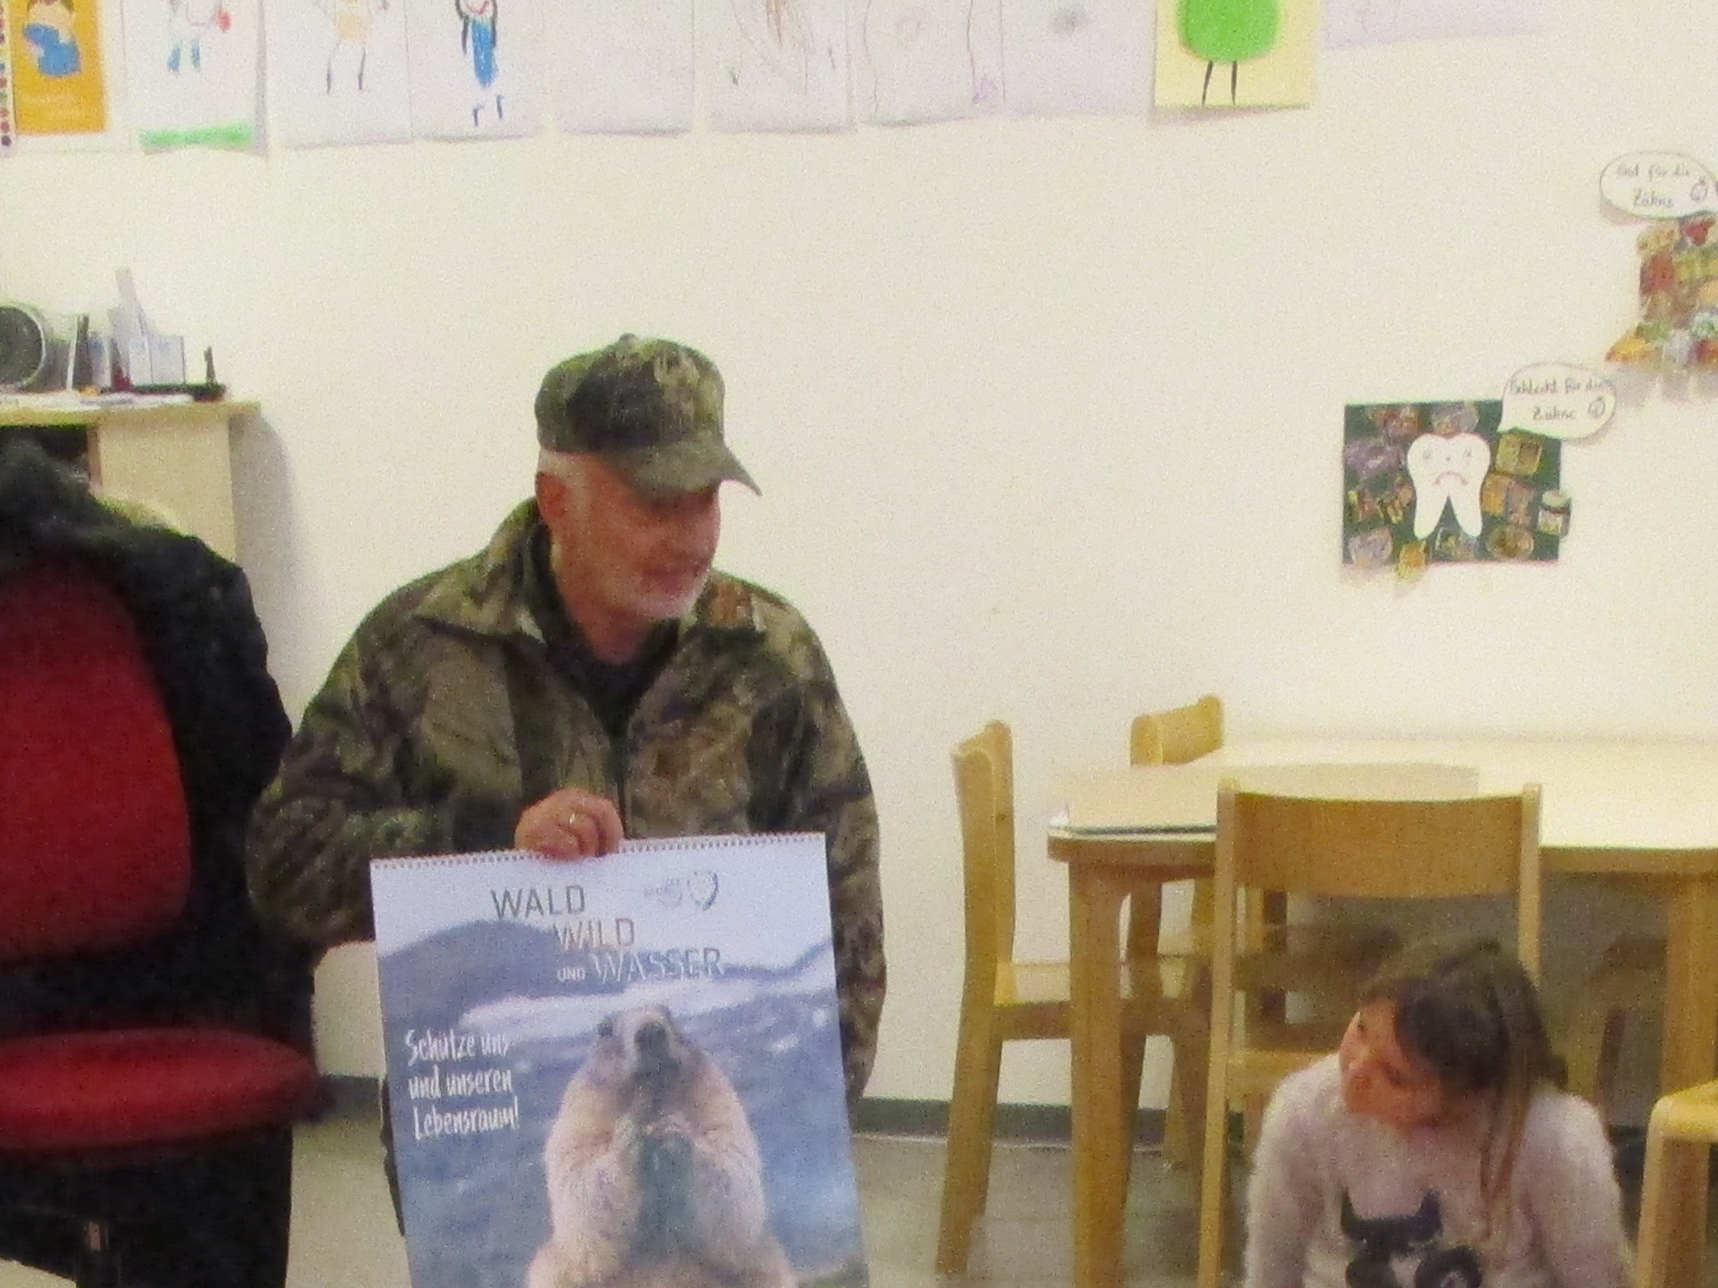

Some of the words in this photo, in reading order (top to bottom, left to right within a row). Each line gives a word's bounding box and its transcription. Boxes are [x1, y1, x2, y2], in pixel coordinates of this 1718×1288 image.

[490, 884, 586, 919] WALD
[552, 917, 635, 950] WILD
[556, 967, 587, 982] UND
[589, 946, 725, 985] WASSER
[480, 1032, 510, 1057] uns
[408, 1064, 441, 1100] und
[446, 1068, 514, 1097] unseren
[413, 1094, 520, 1141] Lebensraum!
